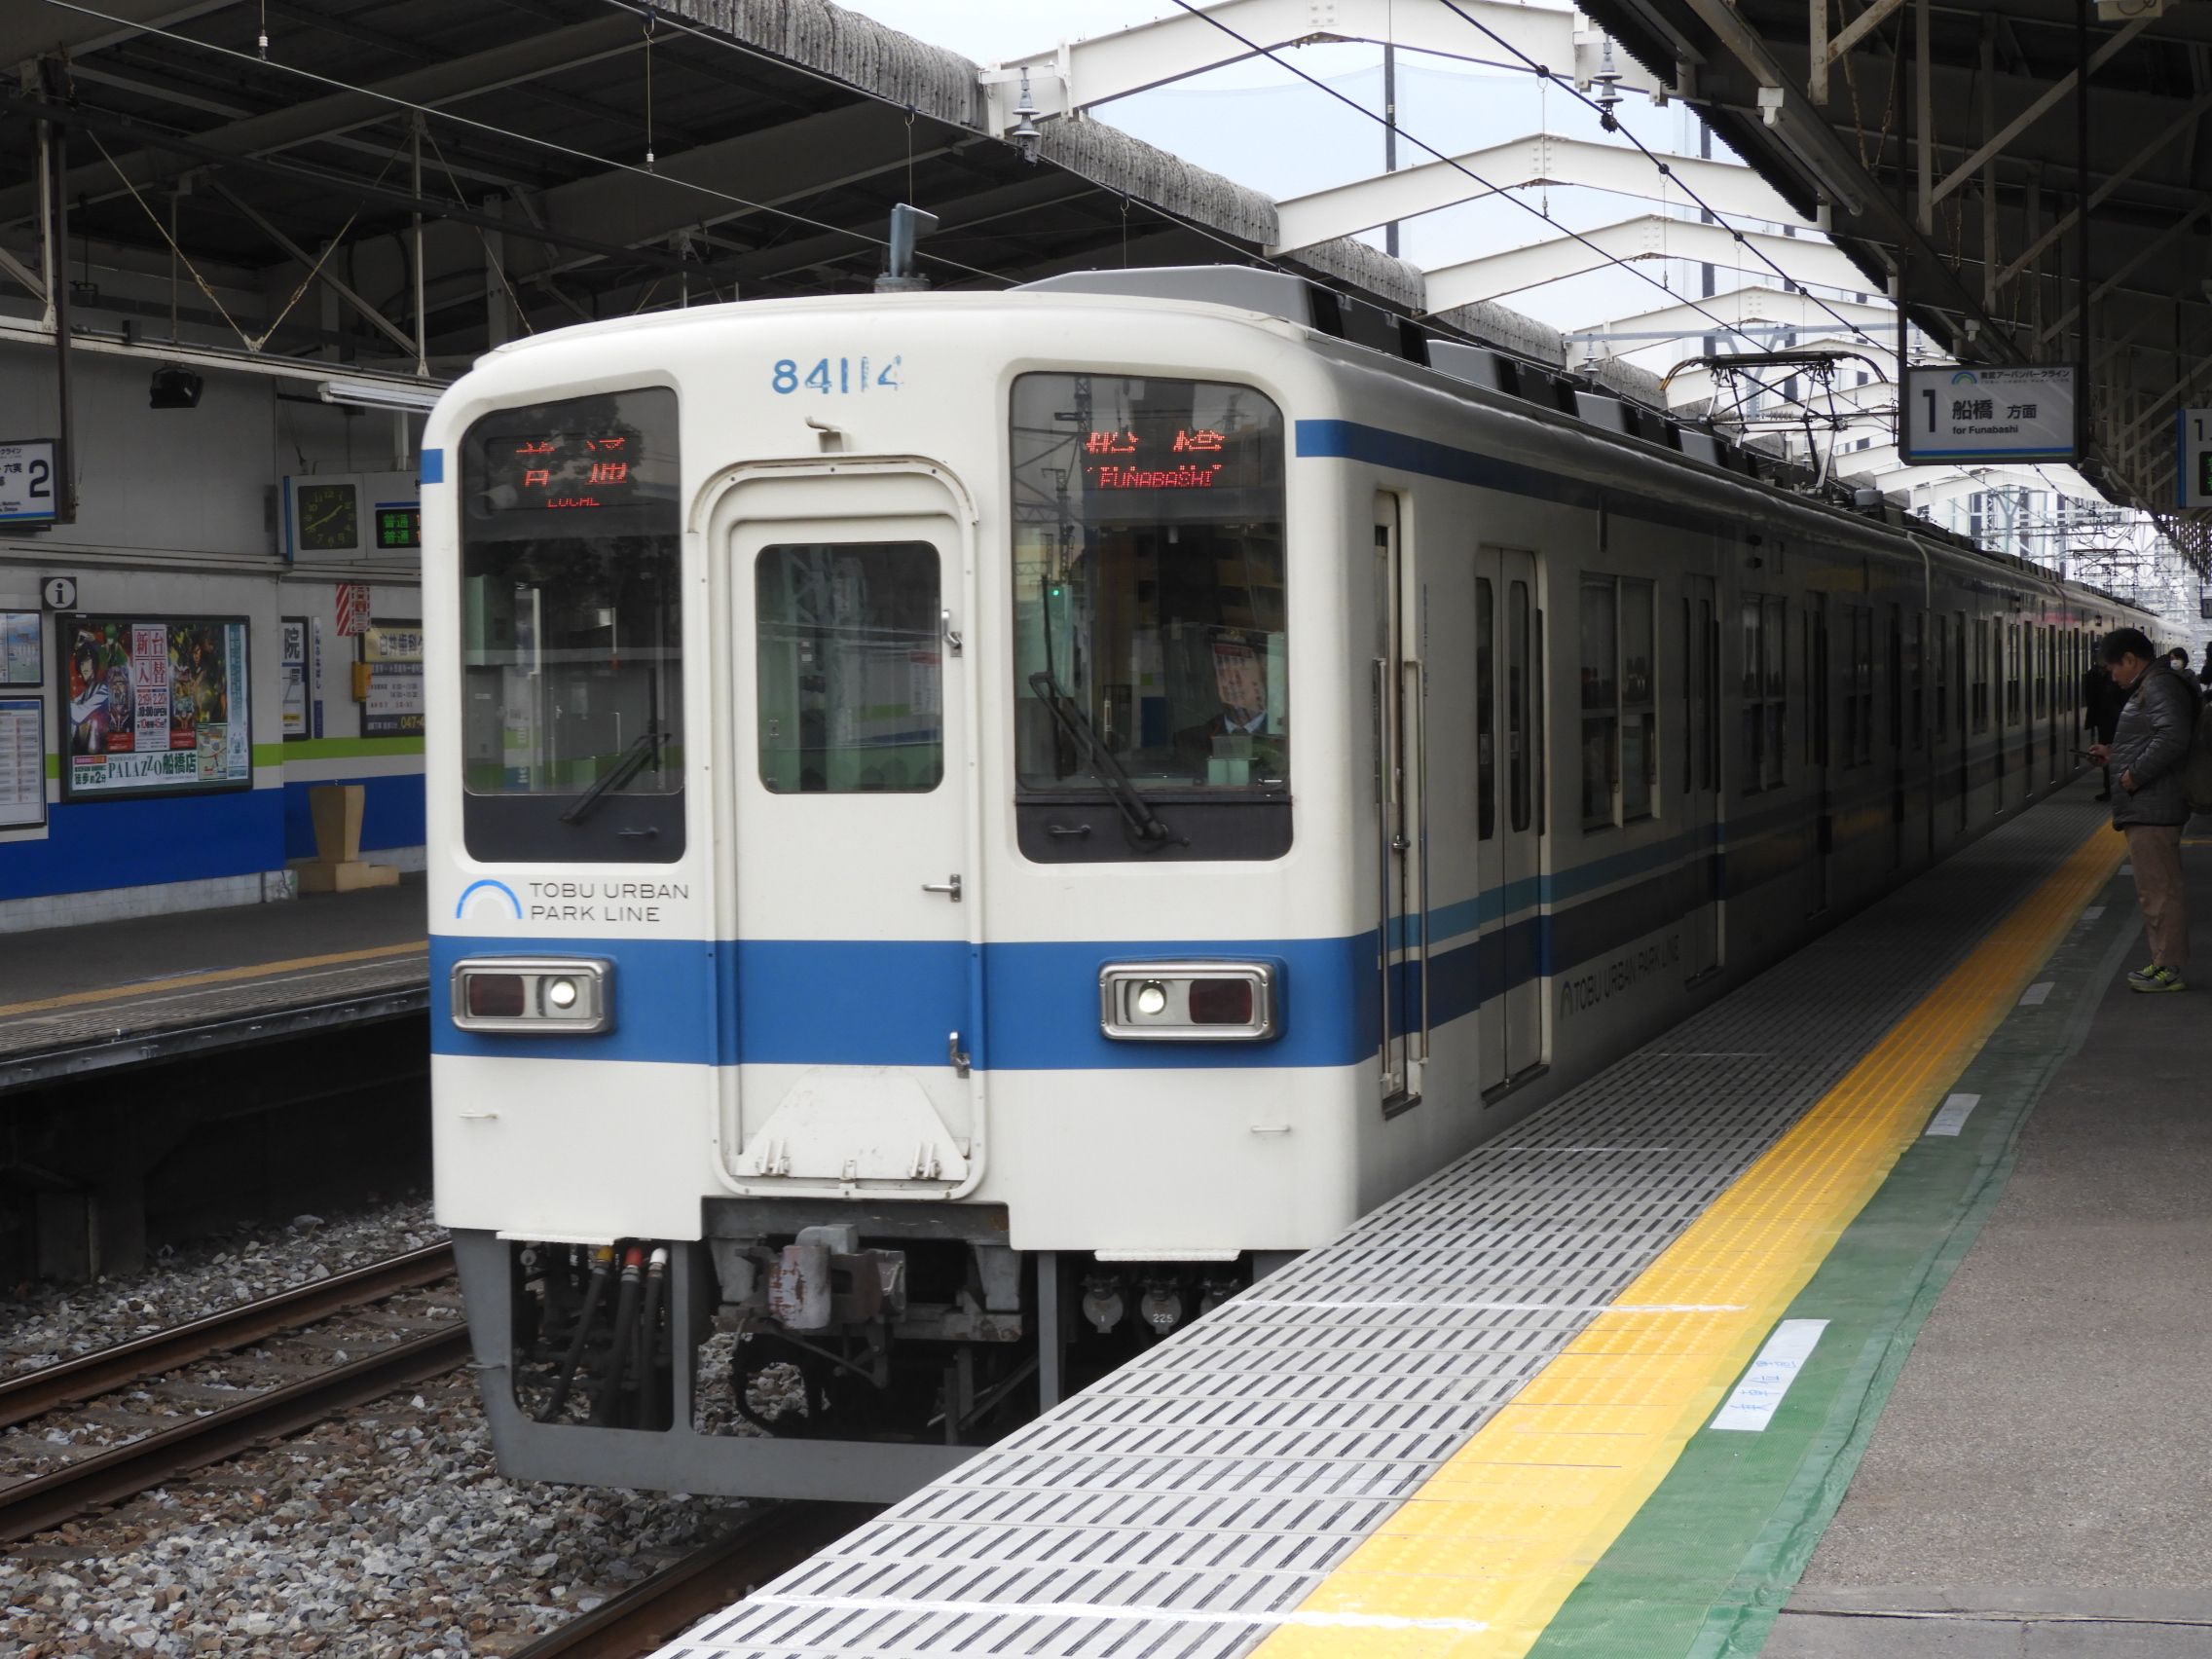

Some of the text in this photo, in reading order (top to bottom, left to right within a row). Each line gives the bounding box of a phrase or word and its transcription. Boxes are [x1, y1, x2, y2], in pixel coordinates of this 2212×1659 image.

[1980, 370, 2070, 380] 東武アーバンパークライン
[1922, 389, 1936, 432] 1
[1952, 400, 2037, 421] 船橋 方面
[1952, 424, 2018, 435] for Funabashi
[2194, 419, 2203, 442] 1
[29, 460, 51, 498] 2
[1100, 471, 1213, 489] FUNABASHI
[283, 627, 300, 660] 院
[163, 754, 197, 775] 船橋店
[530, 882, 689, 900] TOBU URBAN
[531, 905, 660, 922] PARK LINE
[1573, 972, 1603, 1012] TOBU
